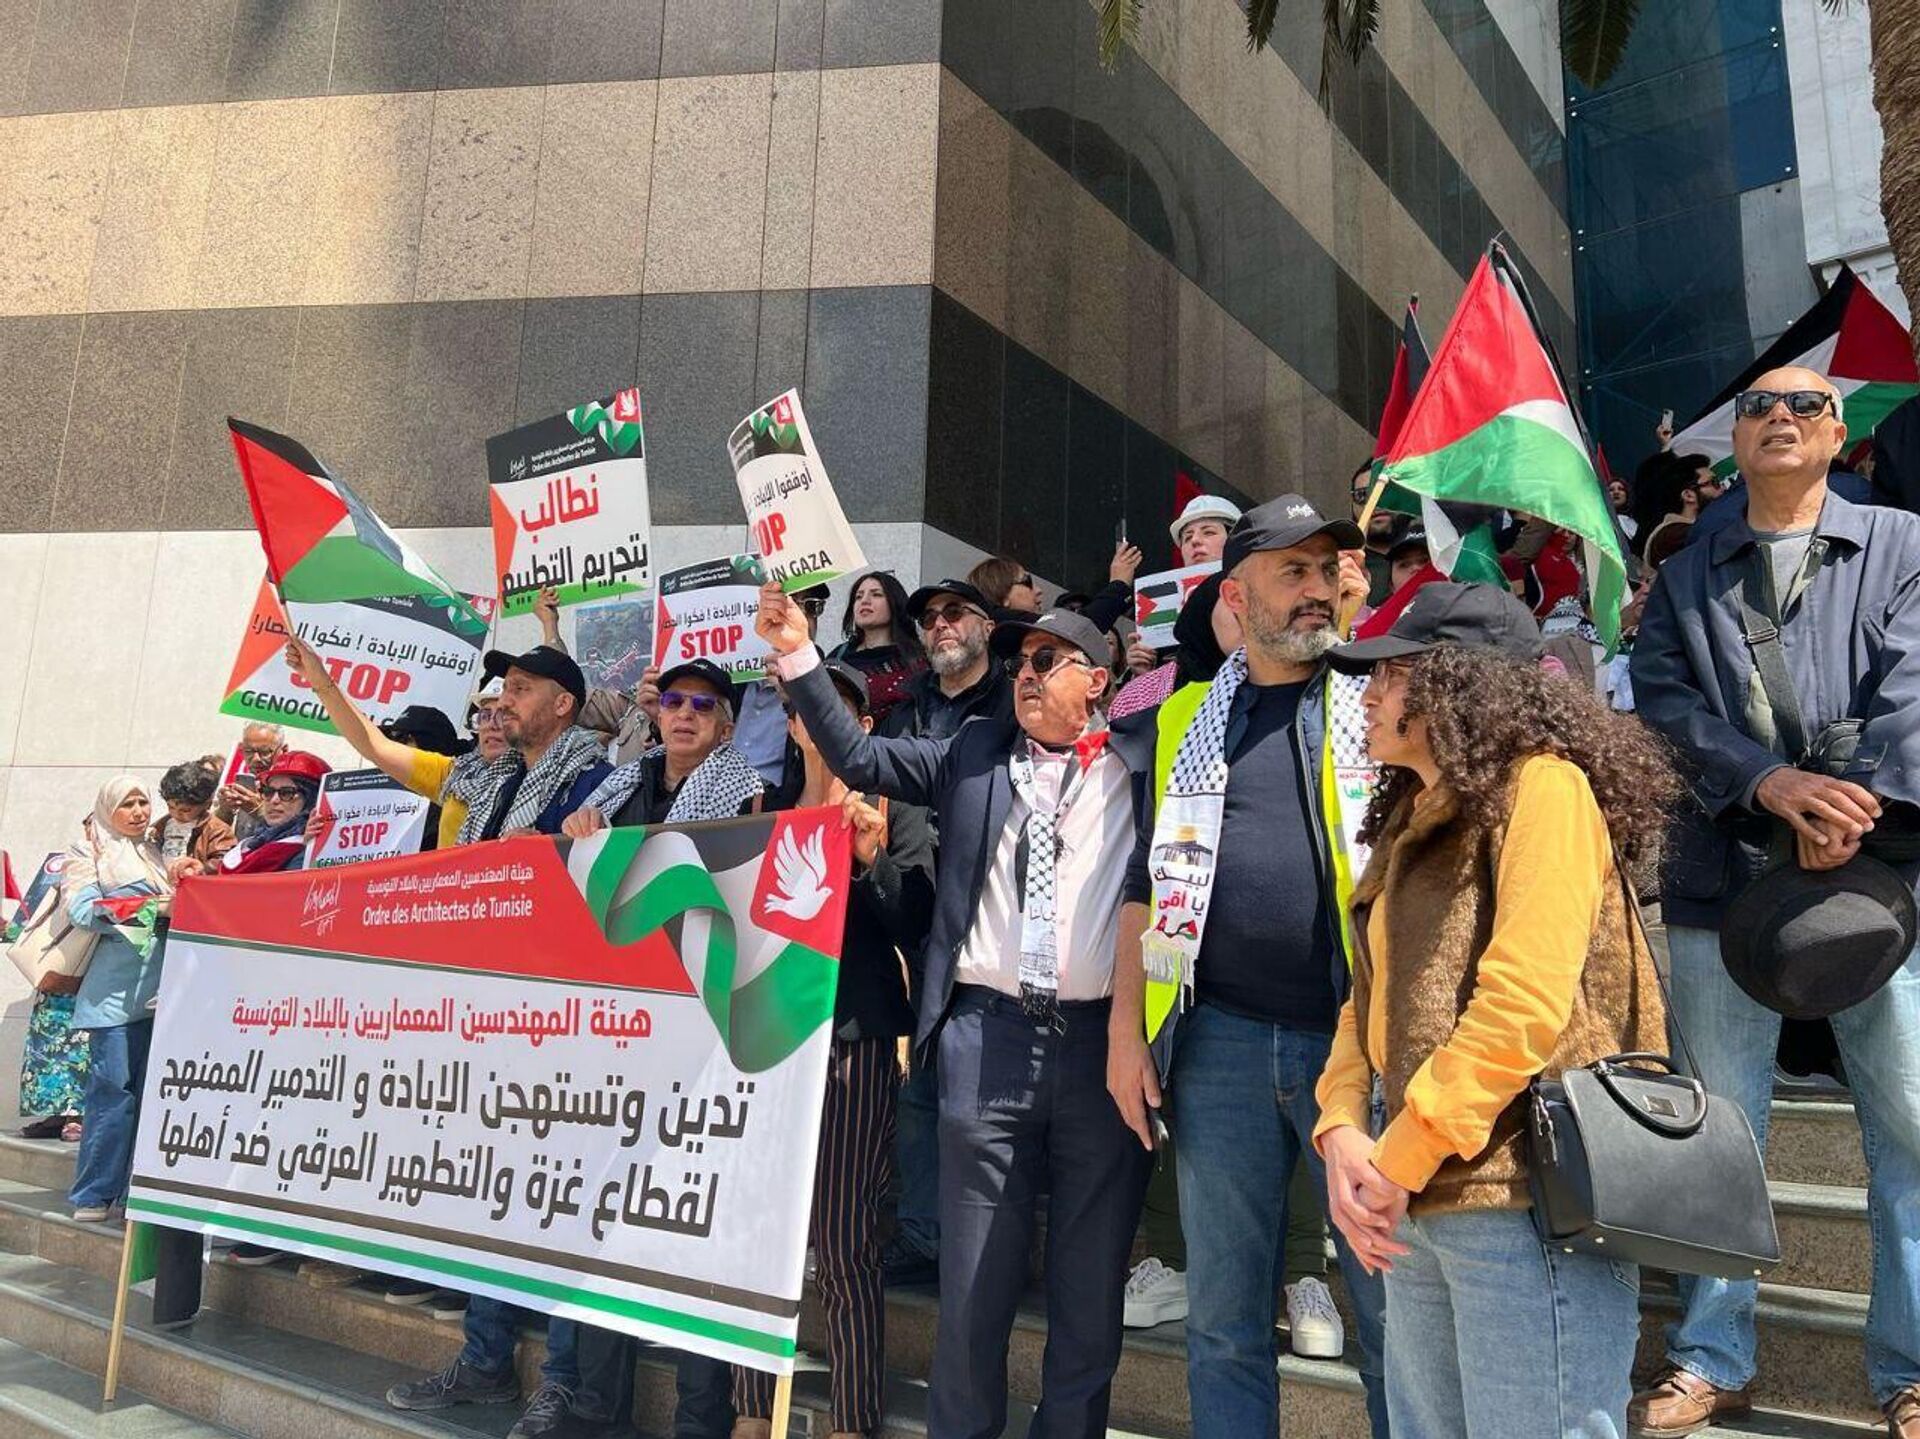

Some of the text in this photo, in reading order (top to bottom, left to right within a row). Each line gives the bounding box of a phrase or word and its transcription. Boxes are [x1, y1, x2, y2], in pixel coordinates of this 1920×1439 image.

[780, 460, 812, 499] أوقفوا
[521, 473, 599, 543] نطالب
[755, 512, 786, 556] OP
[502, 533, 648, 609] بتجريم التطبيع
[771, 550, 832, 583] IN GAZA
[713, 602, 741, 621] الإبادة
[252, 613, 309, 639] الصار!
[367, 637, 418, 664] الإبادة
[680, 624, 743, 660] STOP
[420, 652, 476, 676] أوقفوا
[736, 656, 769, 673] GAZA
[240, 690, 330, 722] GENOCID
[337, 821, 389, 850] STOP
[398, 874, 419, 894] بالبلاد
[418, 870, 461, 894] المعماريين
[461, 866, 509, 890] المهندسين
[510, 862, 534, 885] هيئة
[1154, 866, 1210, 890] لبيك
[366, 877, 399, 899] التونسية
[363, 893, 533, 926] Ordre des Architectes de Tunisie
[1191, 895, 1205, 916] يا
[232, 996, 652, 1048] هيئة المهندسين المعماريين بالبلاد التونسية
[159, 1049, 755, 1153] تدين وتستهجن الإبادة و التدمير الممنهج
[158, 1104, 719, 1241] لقطاع غزة والتطهير العرقي ضد أهلها
